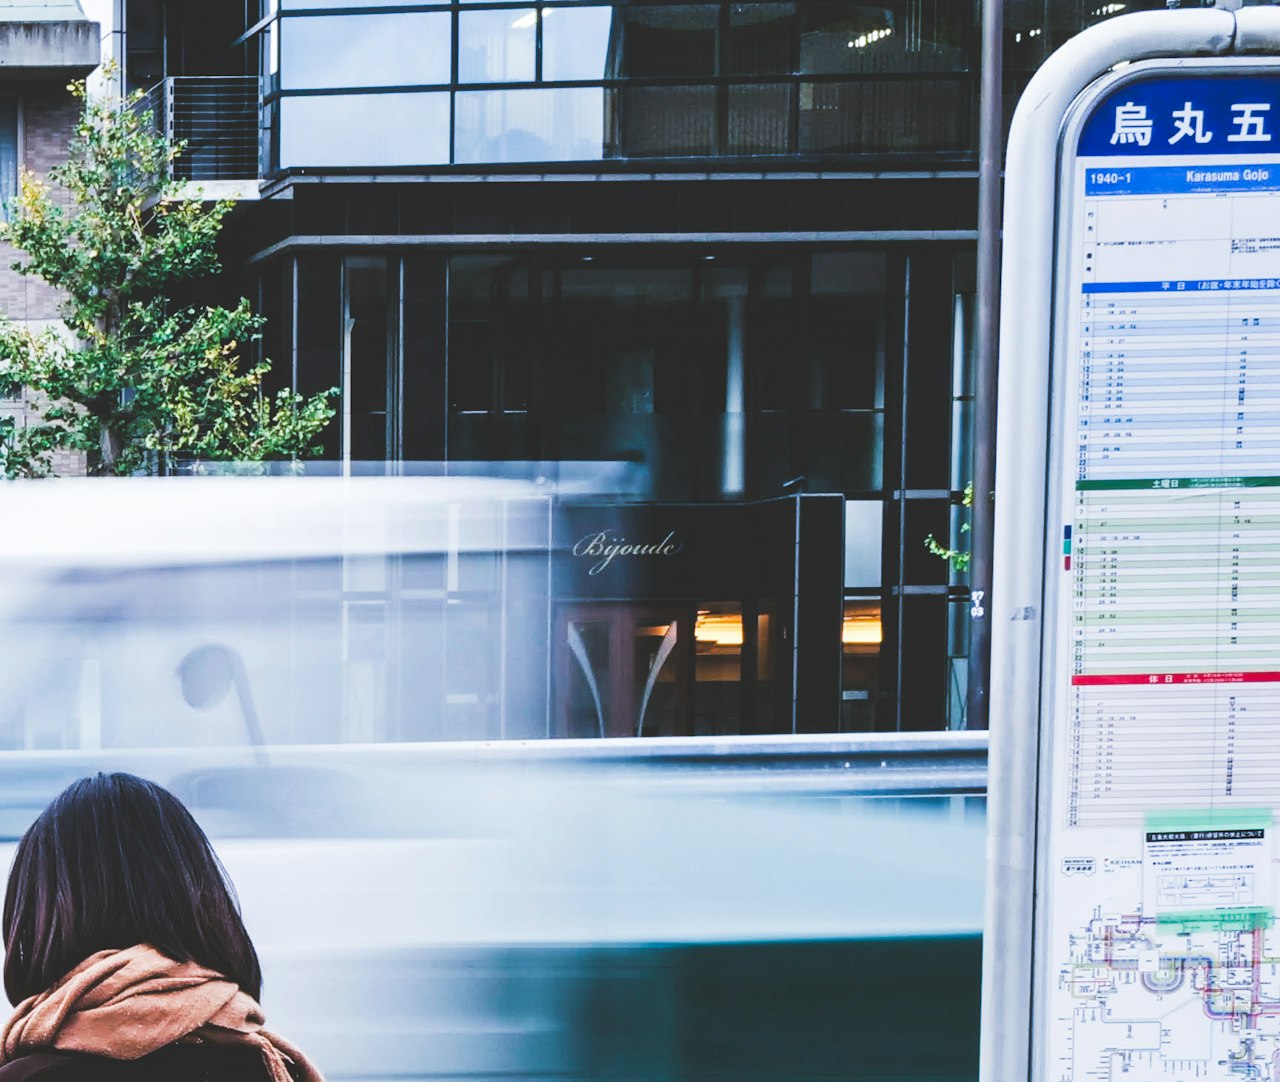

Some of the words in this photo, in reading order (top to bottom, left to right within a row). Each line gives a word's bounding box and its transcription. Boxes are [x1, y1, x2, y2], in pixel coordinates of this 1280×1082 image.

[1110, 102, 1272, 146] 烏丸五
[1090, 172, 1131, 185] 1940-1
[1186, 170, 1239, 184] Karasuma
[1243, 169, 1269, 183] Gojo
[1151, 479, 1179, 489] 土曜日
[971, 591, 984, 600] 97
